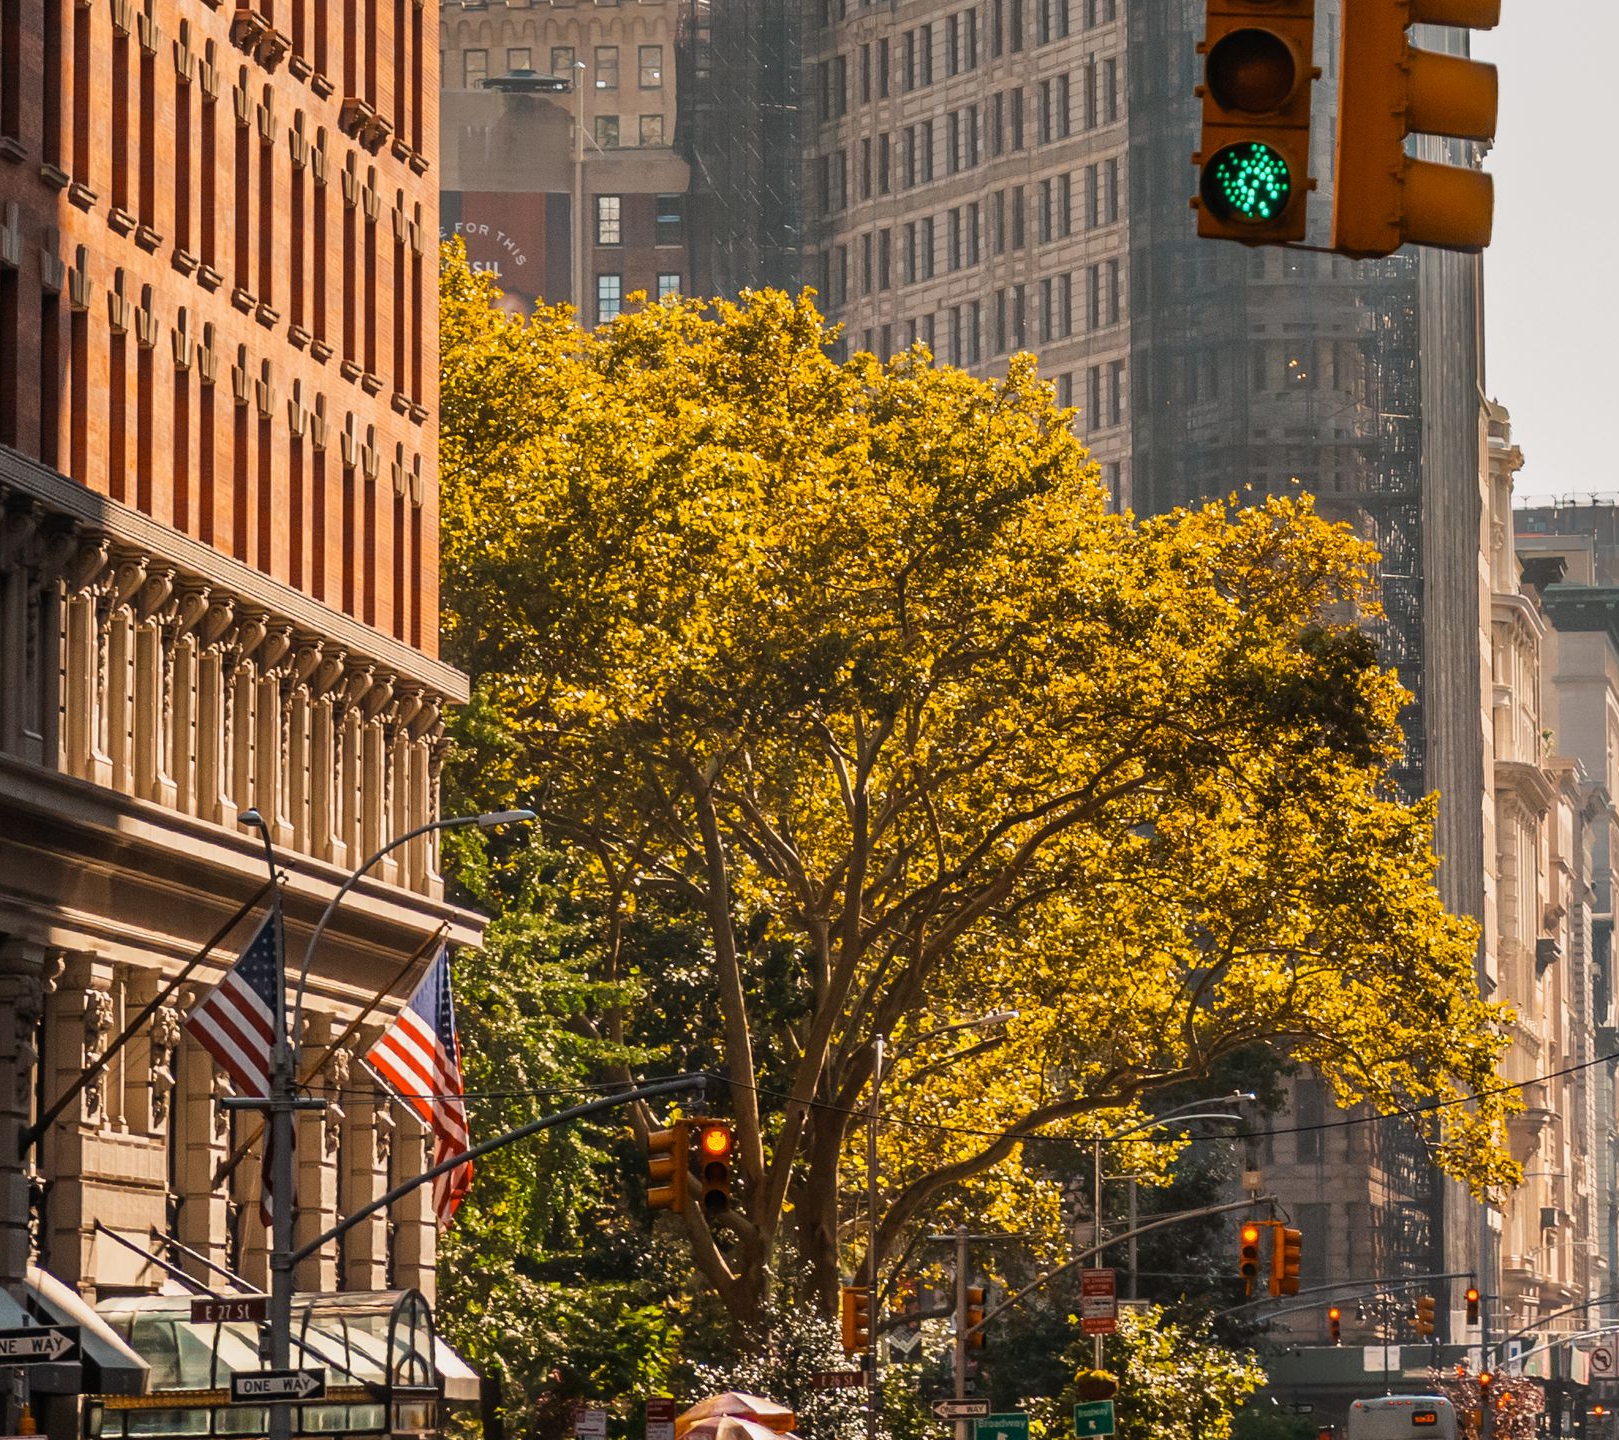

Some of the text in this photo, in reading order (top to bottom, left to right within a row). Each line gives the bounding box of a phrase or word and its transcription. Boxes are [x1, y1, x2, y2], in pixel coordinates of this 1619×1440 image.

[454, 222, 490, 236] FOR
[495, 230, 527, 267] THIS
[205, 1305, 212, 1320] E
[218, 1304, 231, 1320] 27
[31, 1337, 65, 1352] WAY
[243, 1377, 311, 1393] ONE WAY
[821, 1375, 826, 1386] E
[940, 1404, 985, 1414] ONE WAY
[978, 1419, 1026, 1430] Broadway
